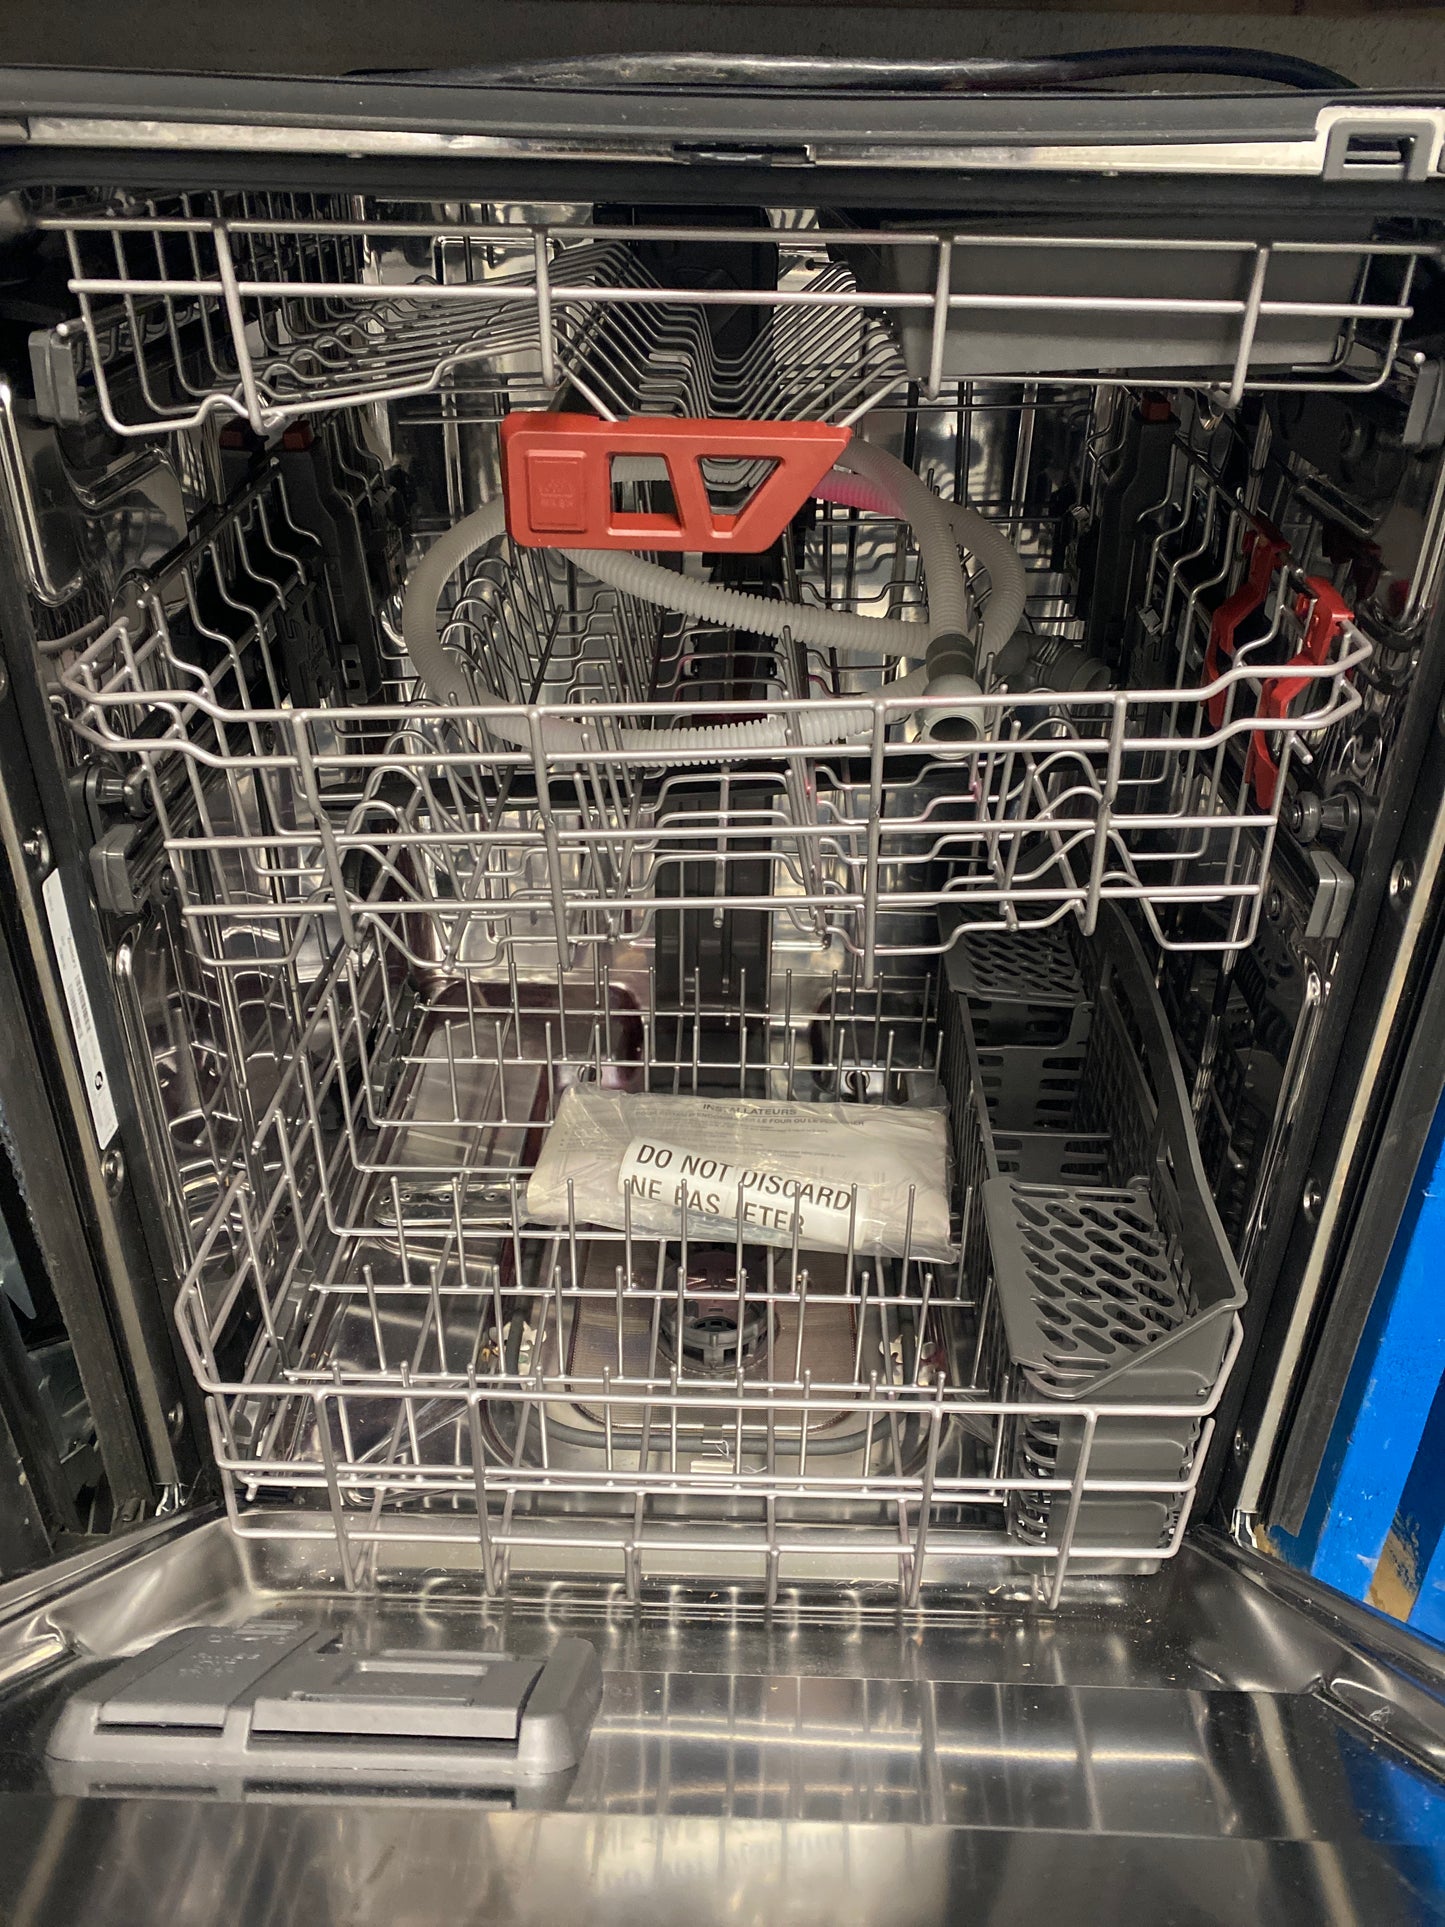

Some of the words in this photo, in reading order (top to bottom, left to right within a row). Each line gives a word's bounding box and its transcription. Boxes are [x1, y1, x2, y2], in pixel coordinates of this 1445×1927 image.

[631, 1174, 662, 1202] NE
[674, 1185, 720, 1215] PAS
[636, 1144, 673, 1169] DO
[680, 1154, 735, 1183] NOT
[740, 1169, 853, 1212] DISCARD
